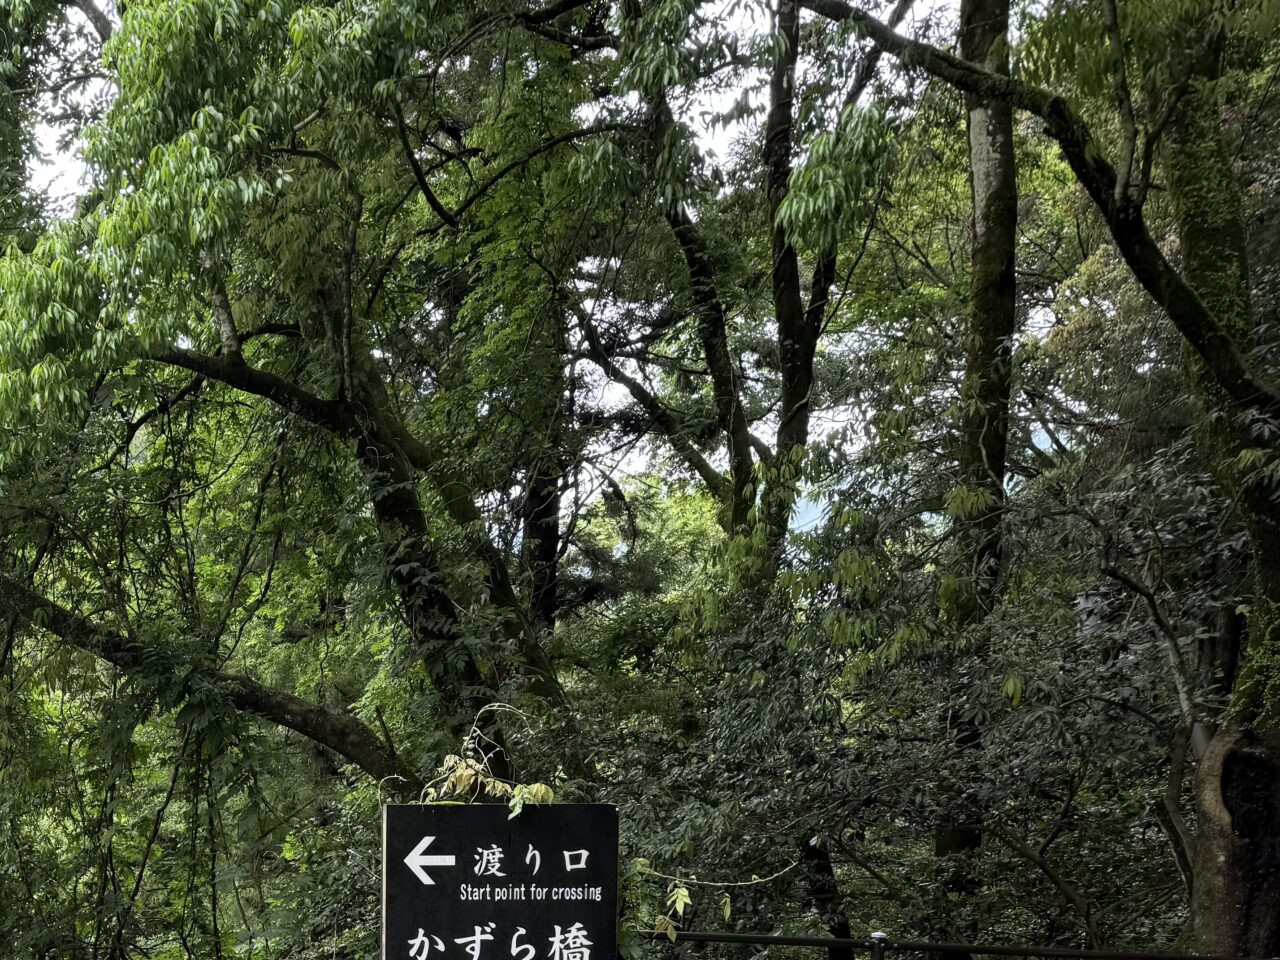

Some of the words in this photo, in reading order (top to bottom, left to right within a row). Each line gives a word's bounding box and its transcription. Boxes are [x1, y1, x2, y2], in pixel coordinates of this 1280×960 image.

[473, 843, 590, 877] 渡り口
[460, 883, 491, 901] Start
[494, 884, 526, 902] point
[529, 883, 549, 900] for
[551, 884, 602, 902] crossing
